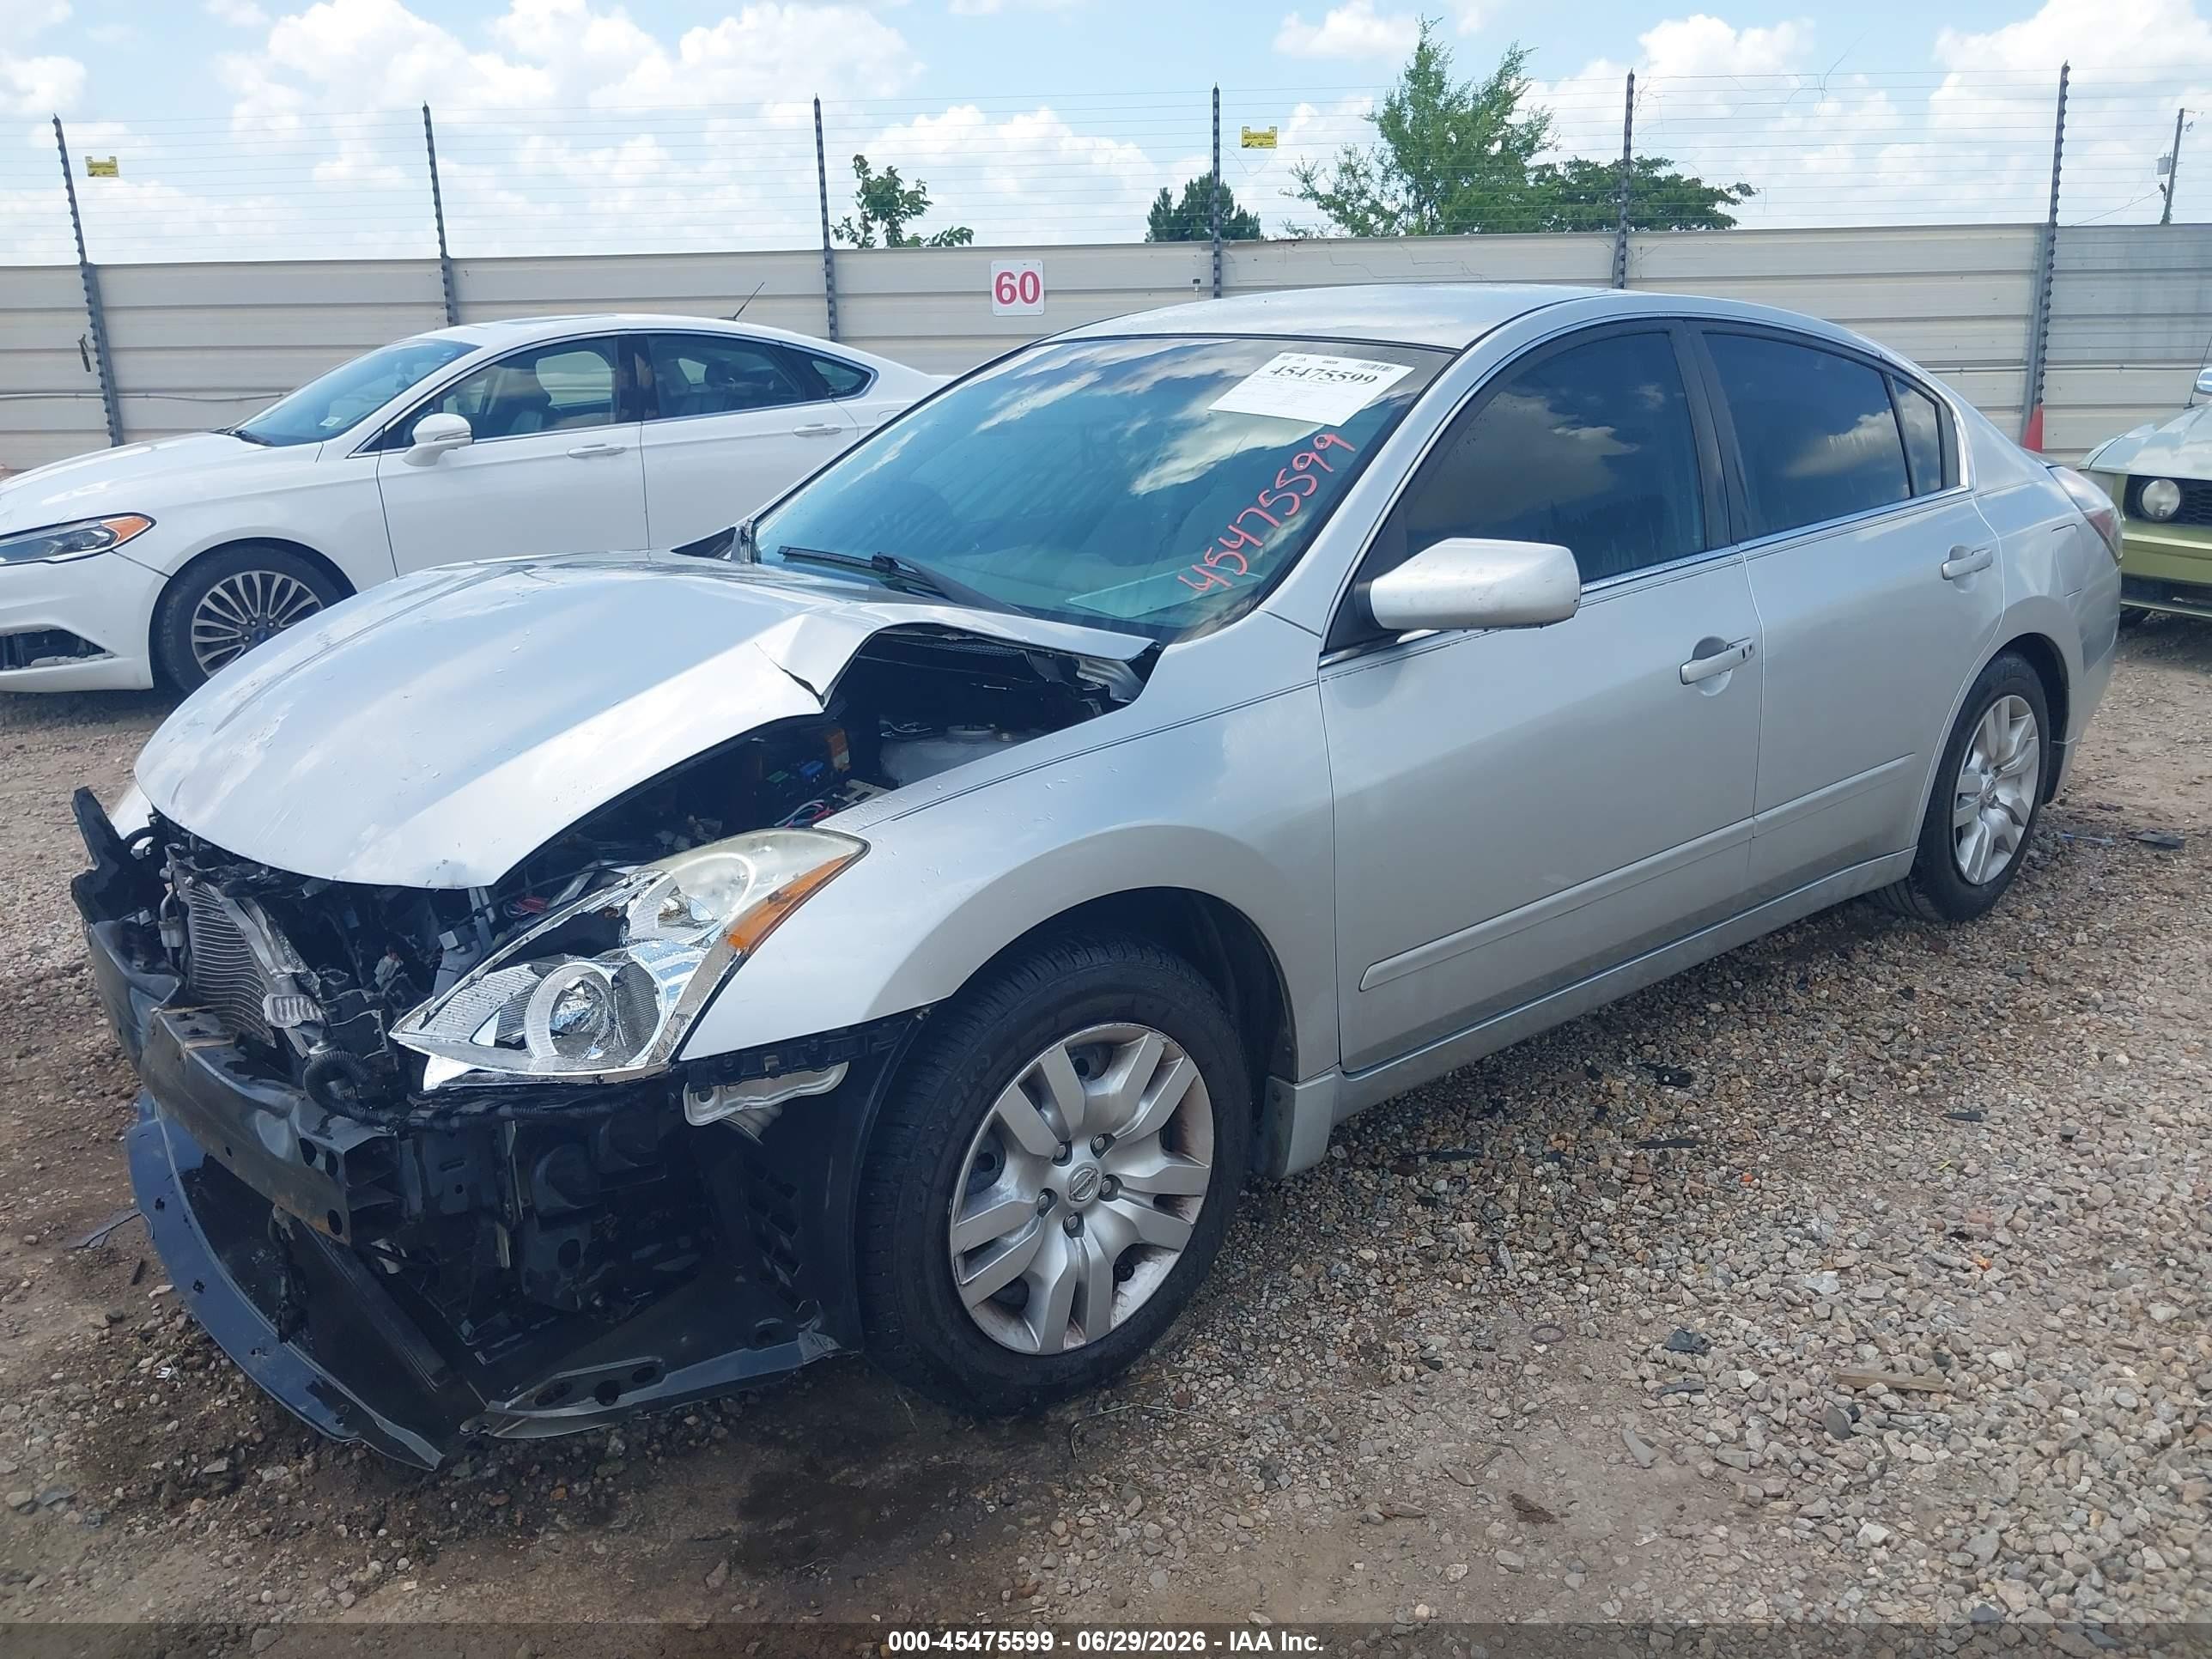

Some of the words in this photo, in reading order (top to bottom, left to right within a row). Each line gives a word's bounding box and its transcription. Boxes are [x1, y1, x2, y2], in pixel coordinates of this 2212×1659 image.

[995, 270, 1041, 305] 60
[1270, 365, 1378, 386] 45475599
[1177, 434, 1357, 591] 45475599
